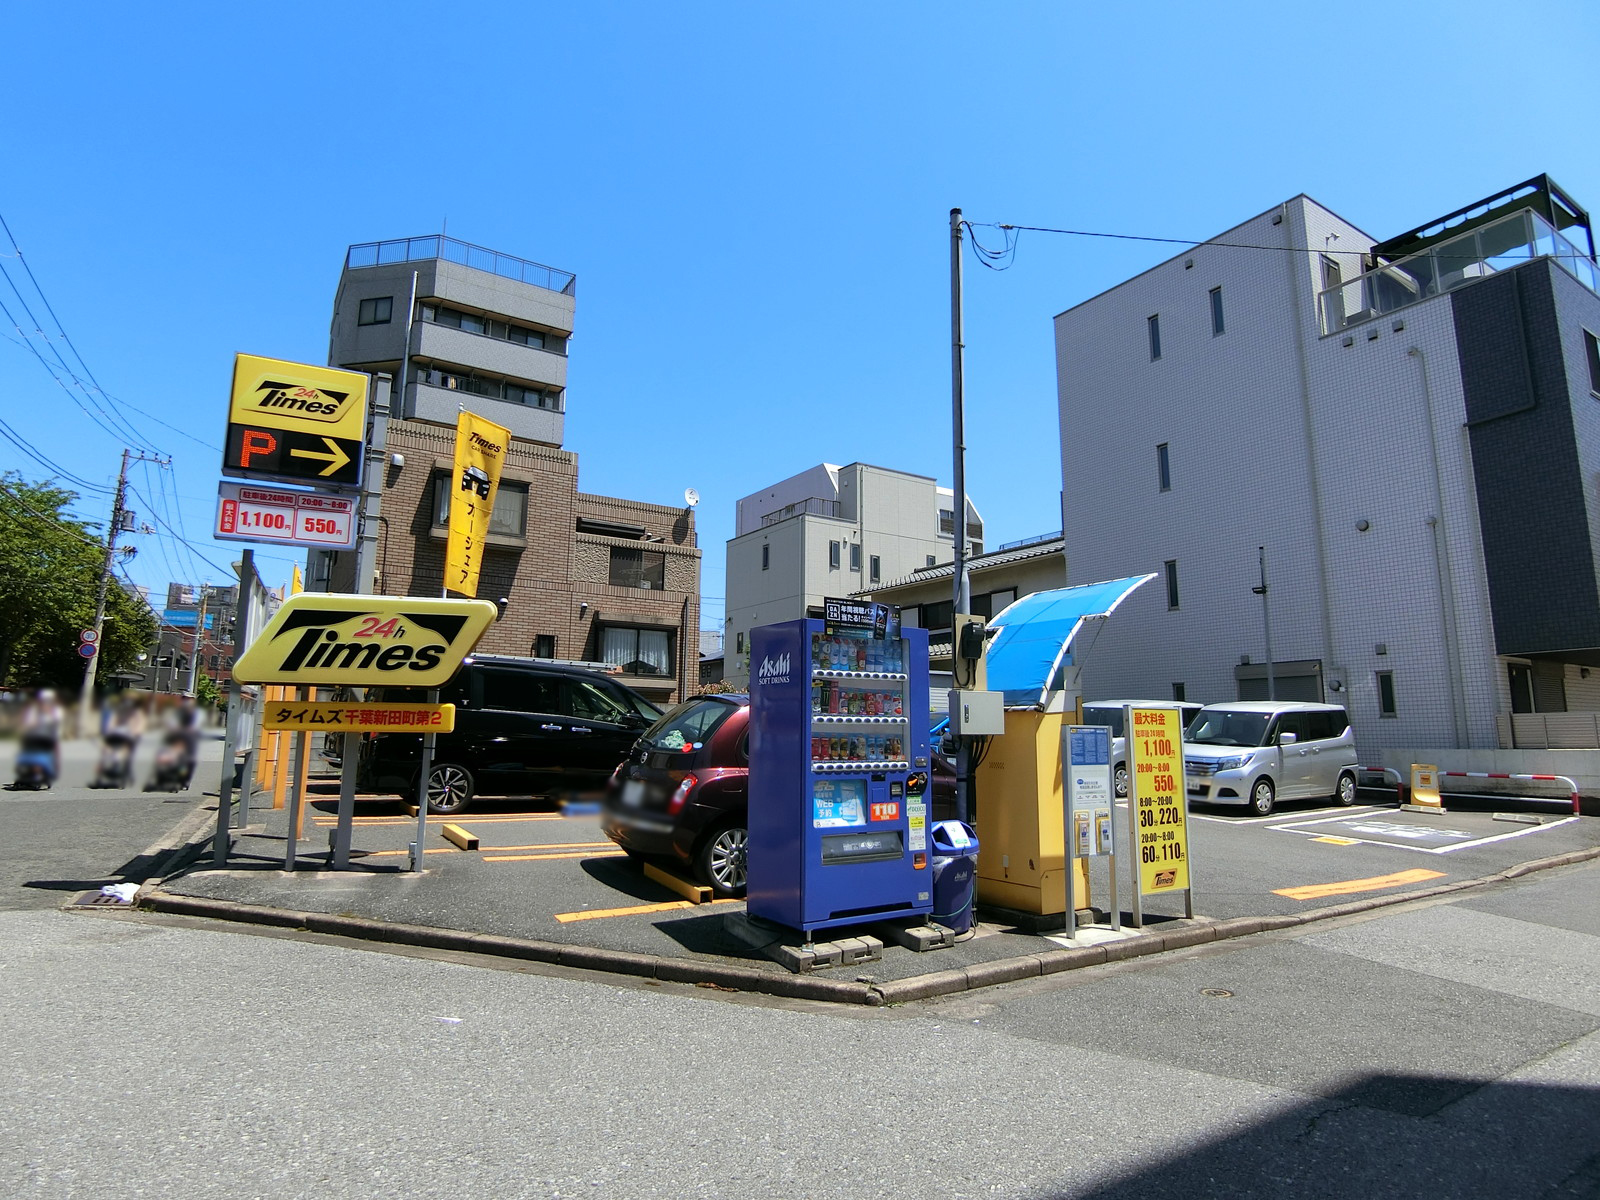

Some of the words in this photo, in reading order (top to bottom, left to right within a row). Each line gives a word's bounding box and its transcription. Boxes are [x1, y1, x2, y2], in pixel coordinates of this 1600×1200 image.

[258, 389, 338, 415] Times
[293, 387, 320, 400] 24h
[240, 429, 277, 468] P
[469, 432, 501, 453] Times
[240, 511, 291, 531] 1,100円
[304, 517, 343, 536] 550円
[353, 617, 406, 640] 24h
[278, 628, 446, 672] Times
[759, 652, 790, 677] Asahi
[759, 677, 771, 686] SOFT
[771, 675, 790, 684] DRINKS
[1134, 712, 1166, 726] 最大料金
[1143, 739, 1176, 757] 1,100円
[872, 803, 897, 816] 110
